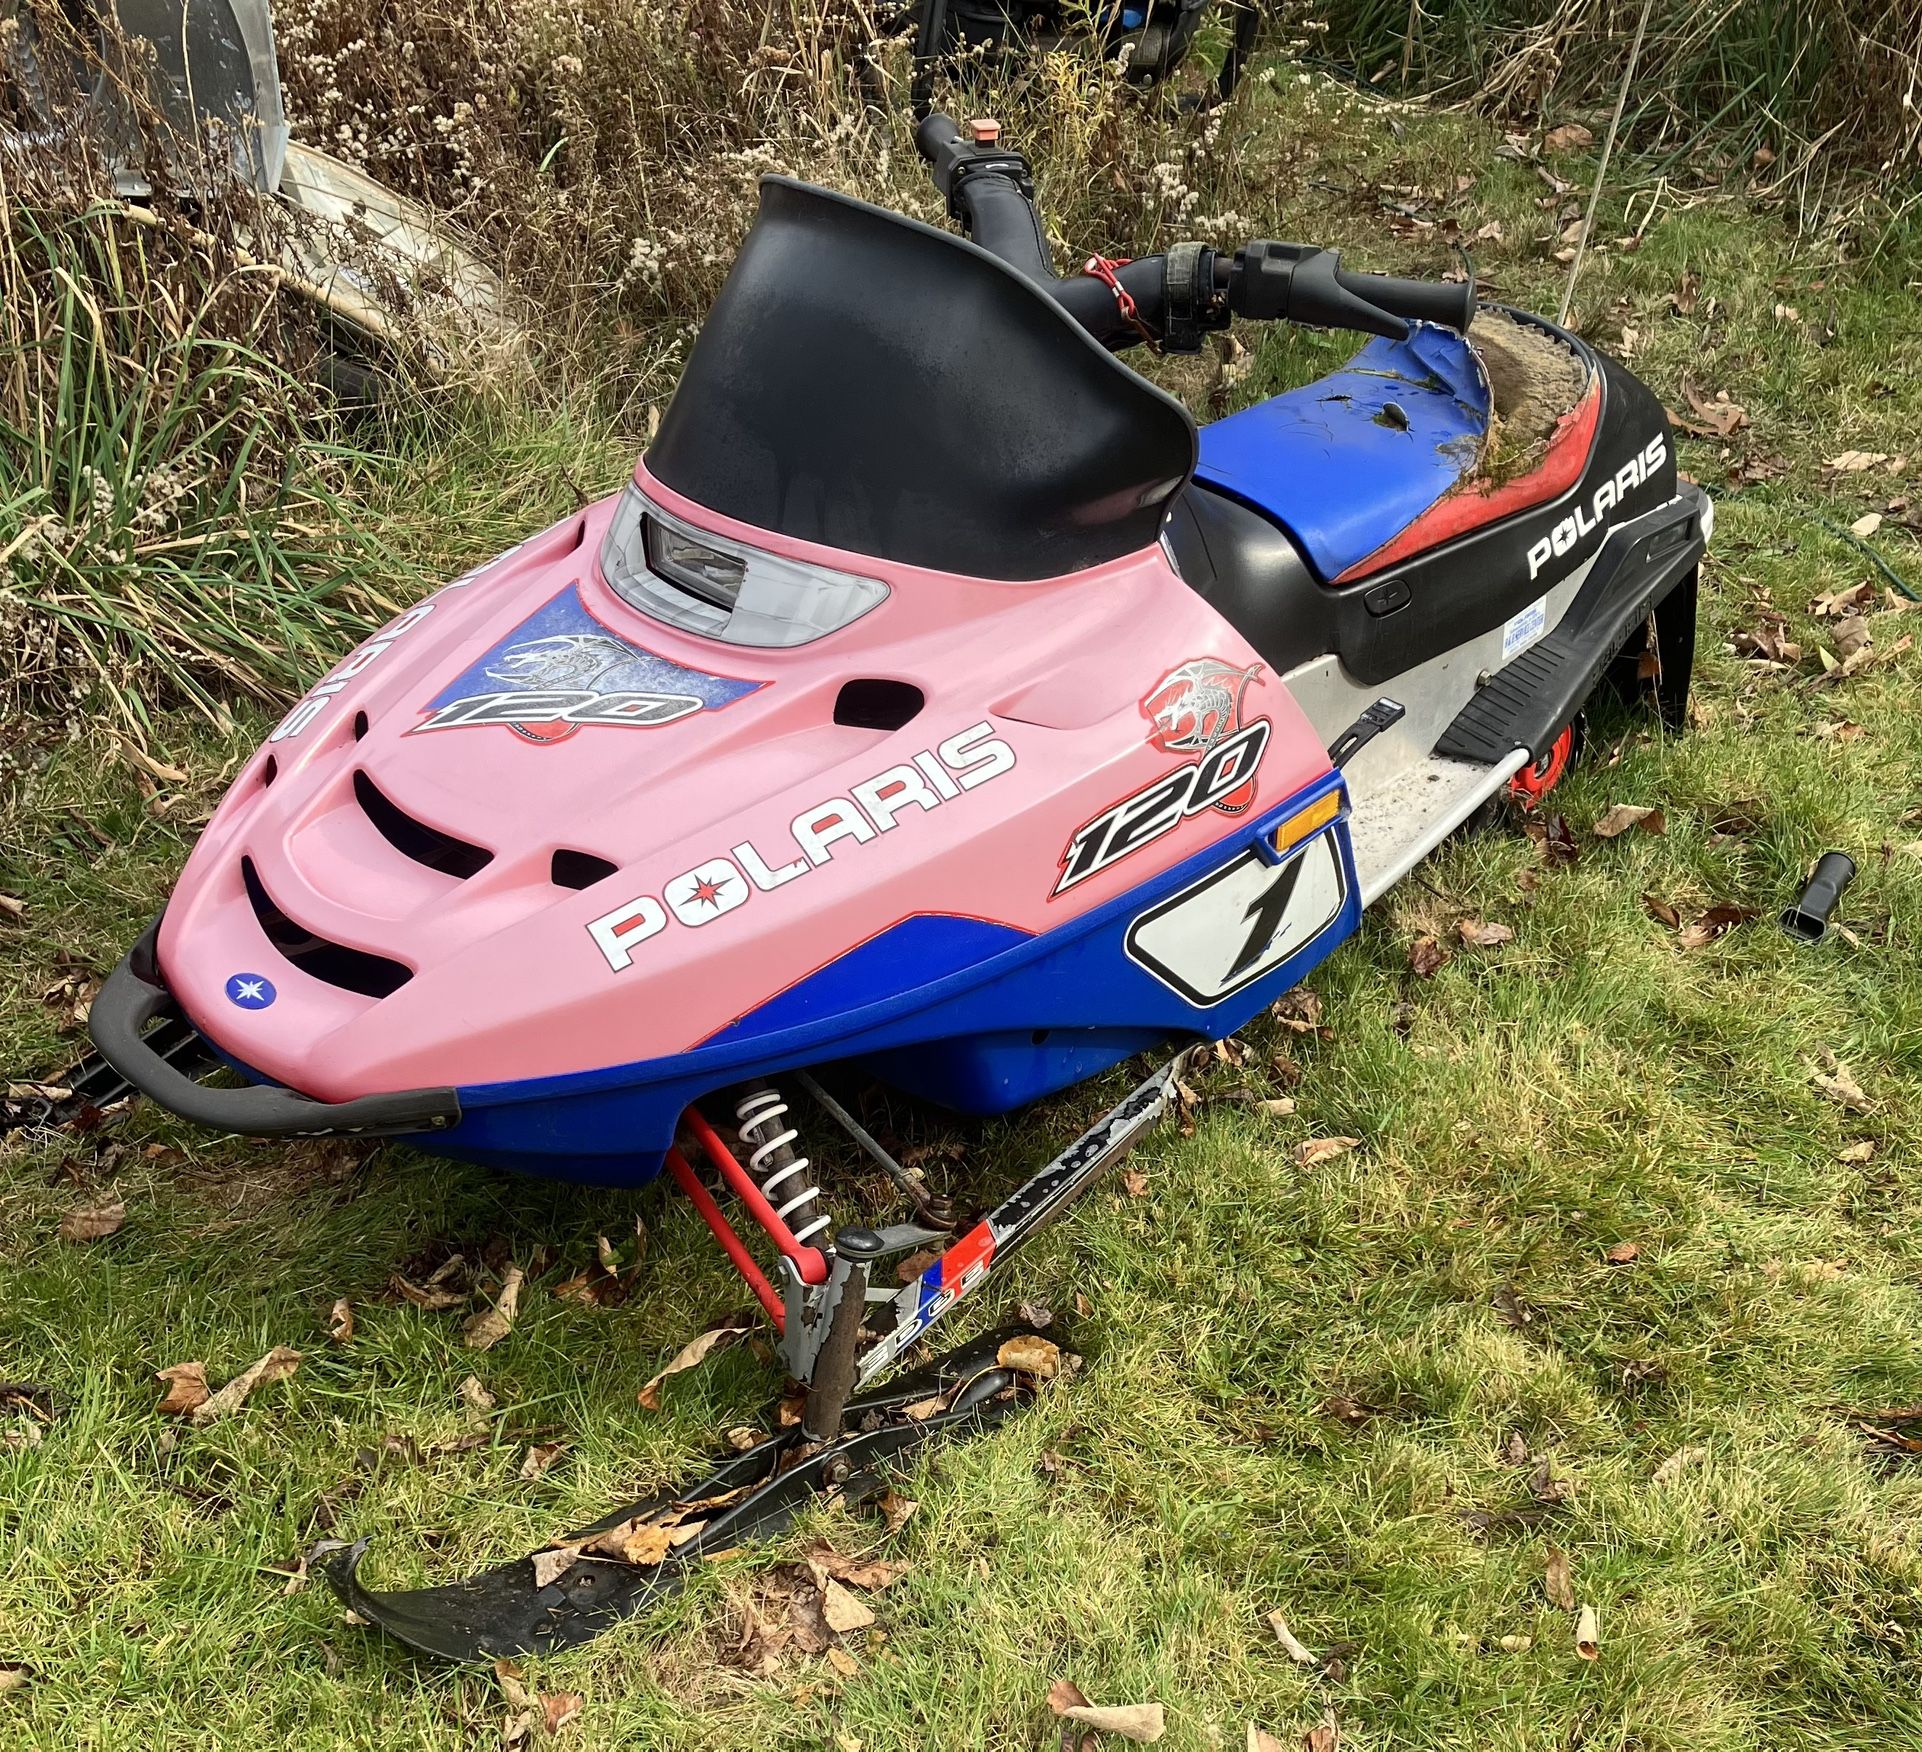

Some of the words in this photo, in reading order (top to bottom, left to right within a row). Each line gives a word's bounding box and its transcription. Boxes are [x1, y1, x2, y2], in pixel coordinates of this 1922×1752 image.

[1527, 431, 1668, 580] POLARIS
[402, 686, 705, 735] 120
[584, 720, 1018, 973] POLARIS
[1050, 718, 1272, 899] 120
[1218, 844, 1311, 989] 1
